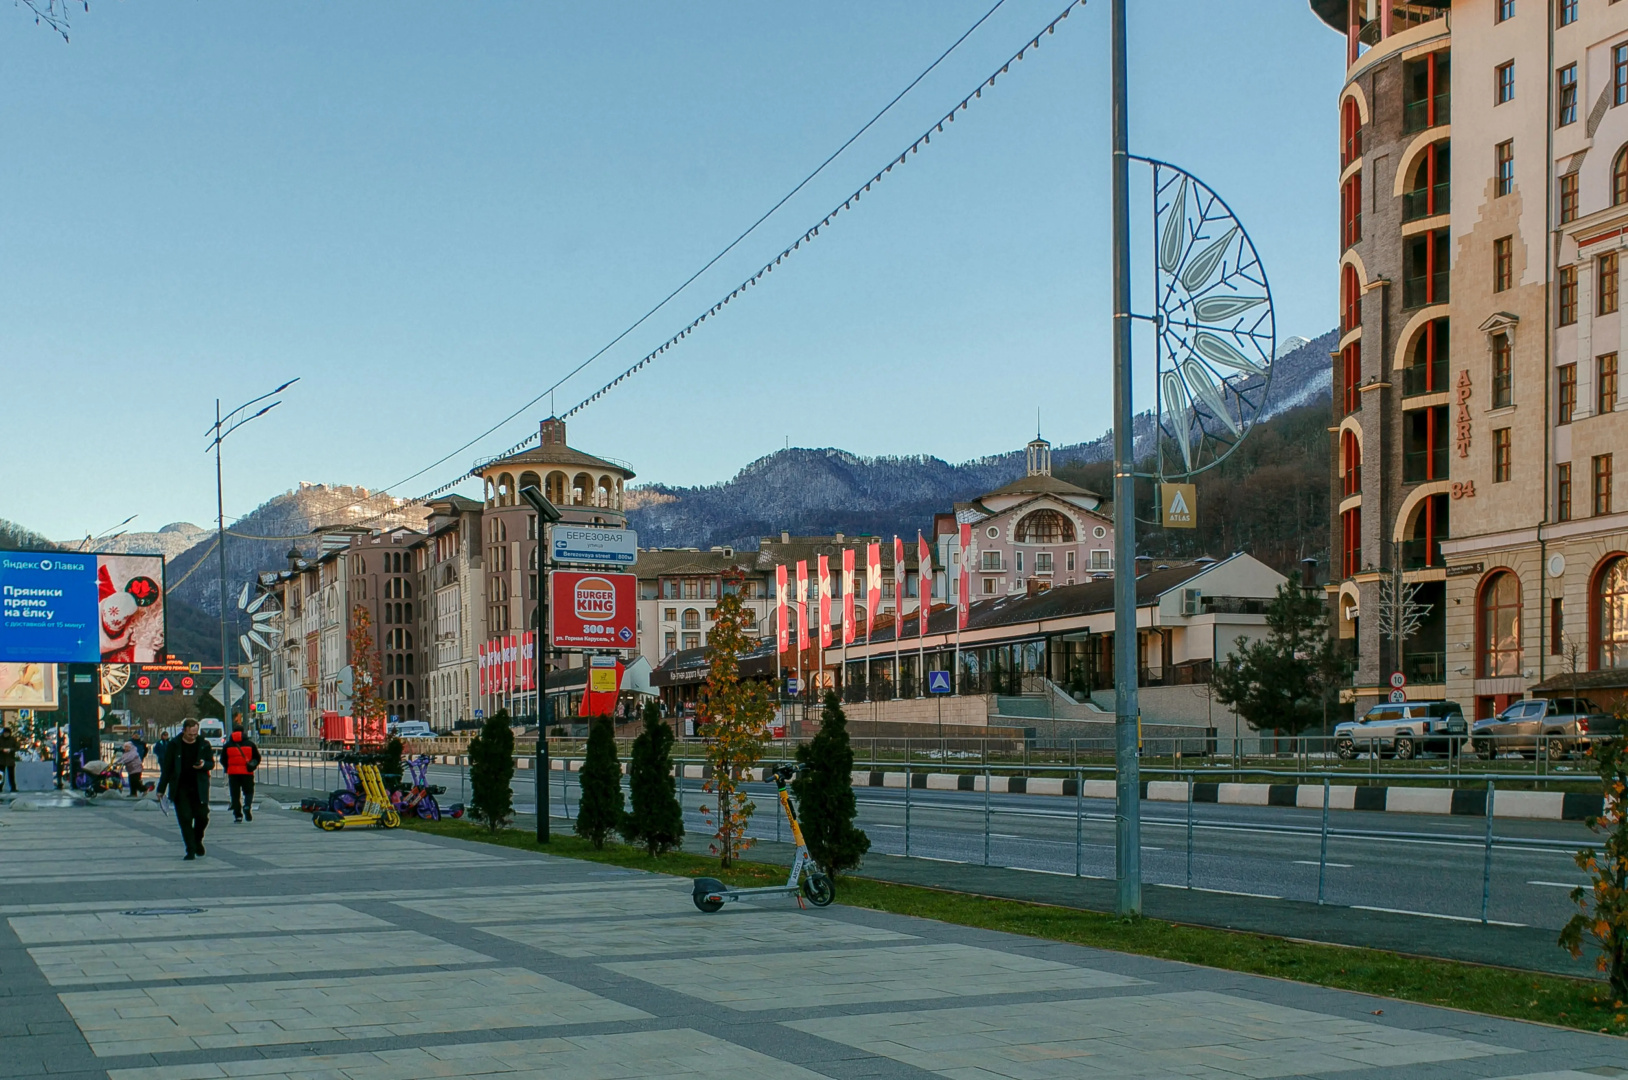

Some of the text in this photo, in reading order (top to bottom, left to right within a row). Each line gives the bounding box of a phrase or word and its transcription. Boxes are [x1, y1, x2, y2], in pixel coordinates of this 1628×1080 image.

[1457, 369, 1472, 458] APART
[1169, 514, 1190, 522] ATLAS
[566, 531, 623, 542] БЕРЕЗОВАЯ
[563, 551, 594, 559] Berezovaya
[2, 559, 85, 571] Яндекс Лавка
[1476, 564, 1481, 572] 5
[3, 585, 63, 598] Пряники
[576, 590, 613, 600] BURGER
[3, 598, 47, 608] прямо
[577, 600, 613, 611] KING
[4, 607, 55, 620] на ёлку
[583, 624, 604, 634] 300
[1394, 676, 1403, 684] 10
